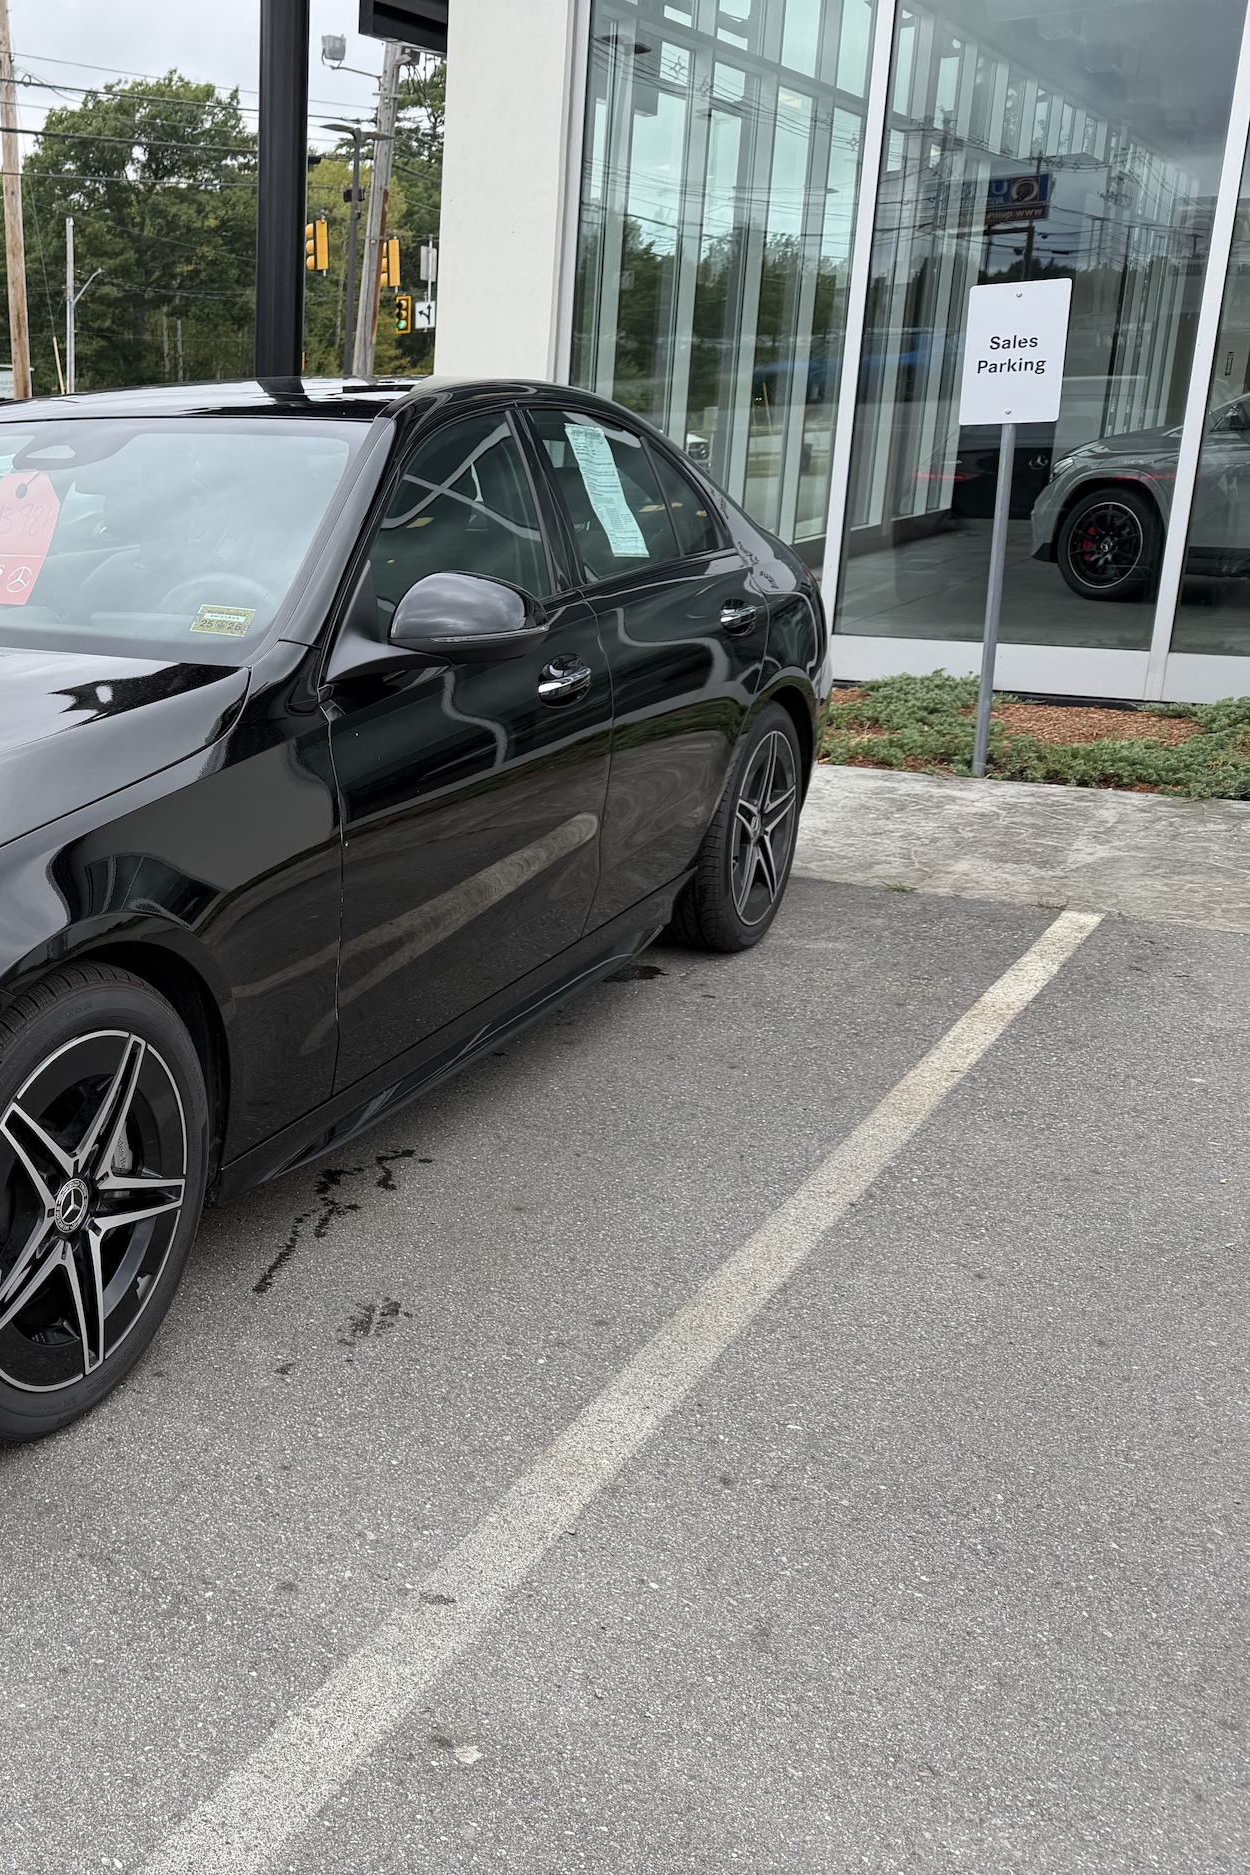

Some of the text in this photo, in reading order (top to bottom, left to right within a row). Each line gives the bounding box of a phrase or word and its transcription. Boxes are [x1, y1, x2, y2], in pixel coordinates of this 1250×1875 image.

[989, 334, 1039, 350] Sales
[977, 357, 1047, 375] Parking
[199, 619, 214, 628] 25
